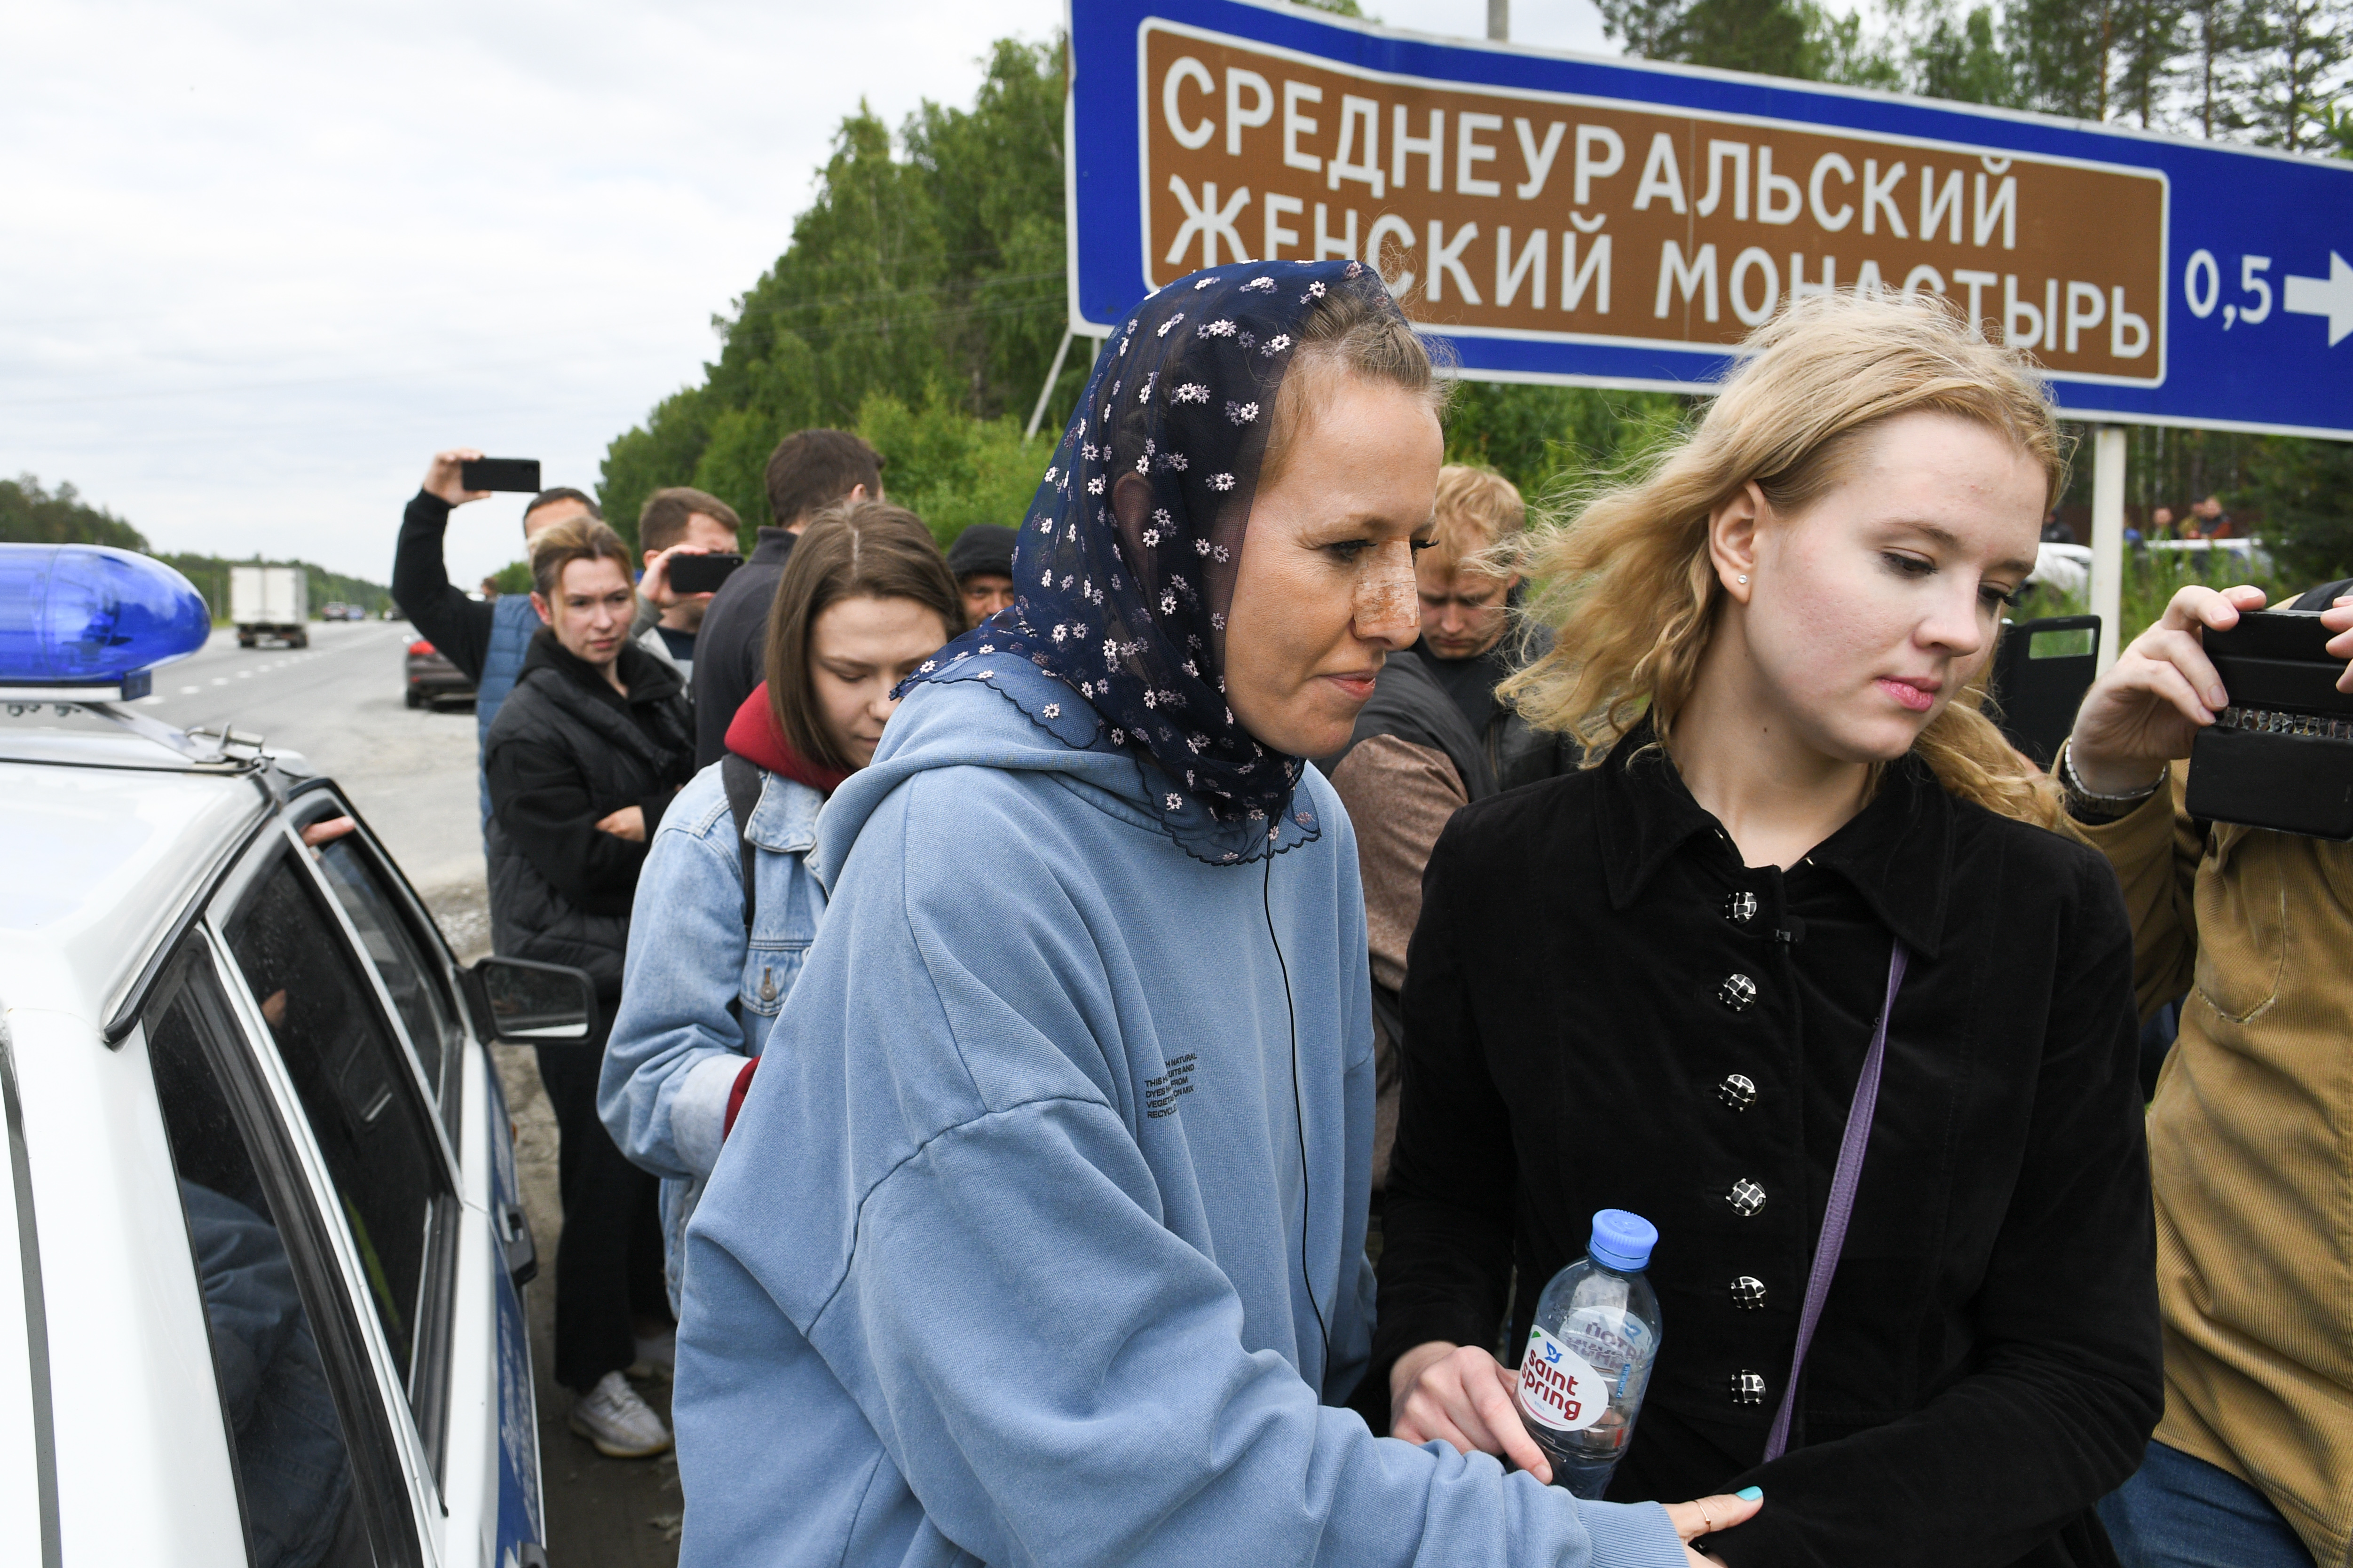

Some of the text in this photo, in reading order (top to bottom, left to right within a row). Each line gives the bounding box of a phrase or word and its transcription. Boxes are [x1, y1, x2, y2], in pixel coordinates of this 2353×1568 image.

[1162, 55, 2018, 250] СРЕДНЕУРАЛЬСКИЙ
[1165, 173, 2151, 359] ЖЕНСКИЙ МОНАСТЫРЬ
[2183, 248, 2273, 331] 0,5
[1144, 1077, 1162, 1088] THIS
[1171, 1053, 1198, 1066] NATURAL
[1146, 1087, 1166, 1098] DYES
[1182, 1064, 1195, 1074] AND
[1171, 1076, 1188, 1088] FROM
[1183, 1085, 1194, 1094] MIX
[1522, 1362, 1582, 1421] spring
[1529, 1349, 1579, 1396] saint
